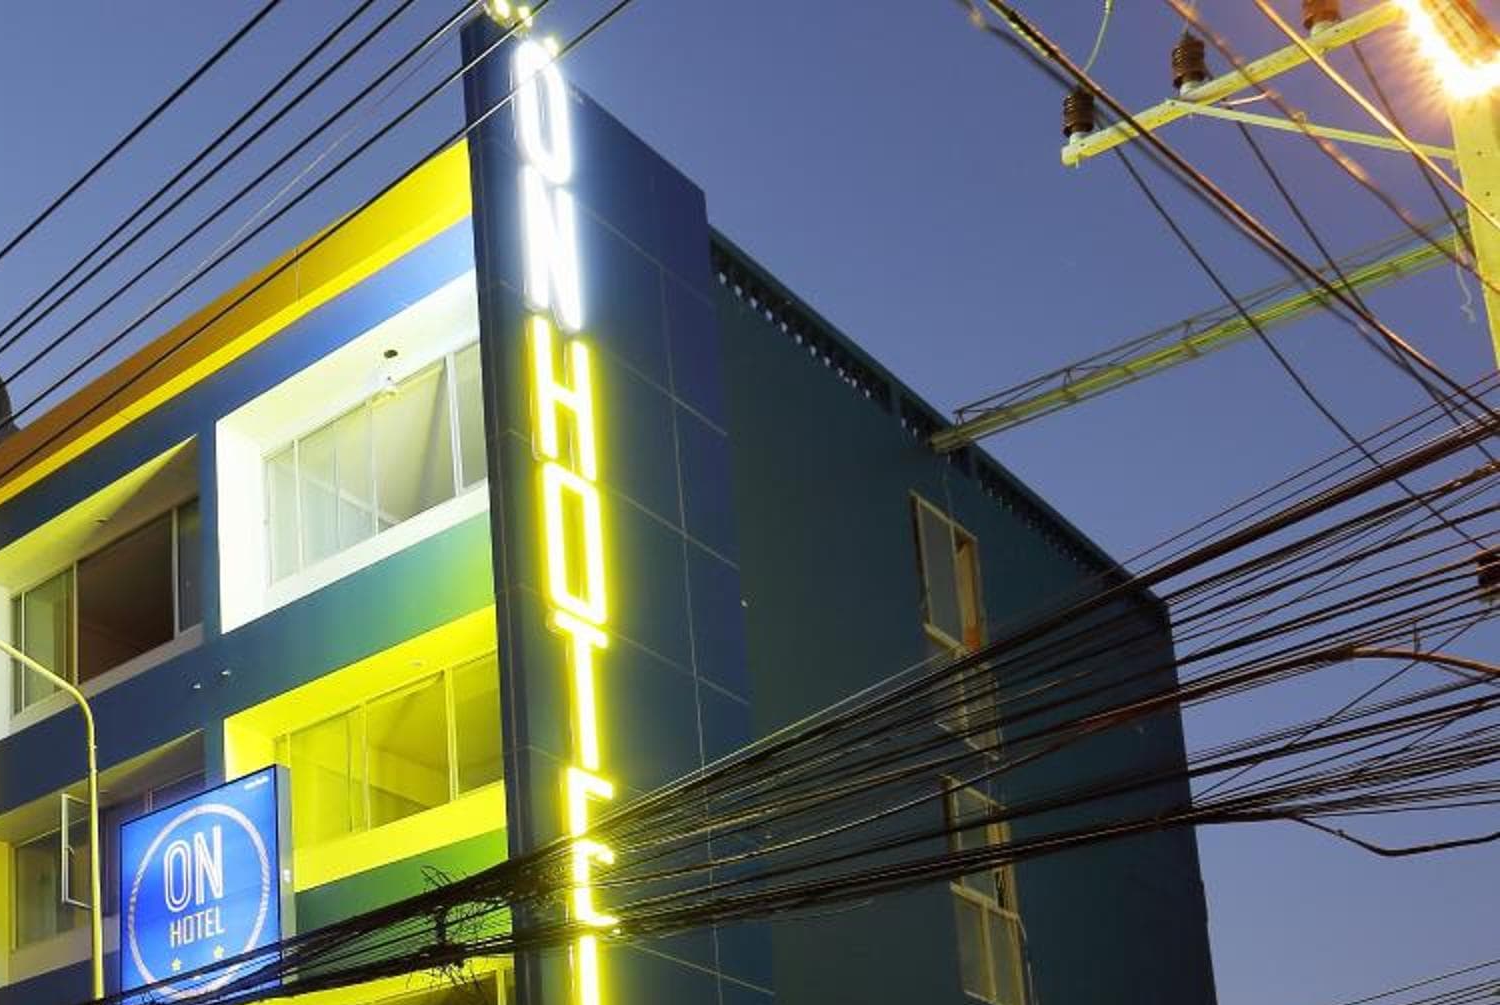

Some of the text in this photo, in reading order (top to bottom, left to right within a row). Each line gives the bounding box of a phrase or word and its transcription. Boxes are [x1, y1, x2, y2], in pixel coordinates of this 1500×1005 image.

[514, 38, 583, 333] ON
[163, 823, 225, 913] ON
[169, 904, 225, 949] HOTEL
